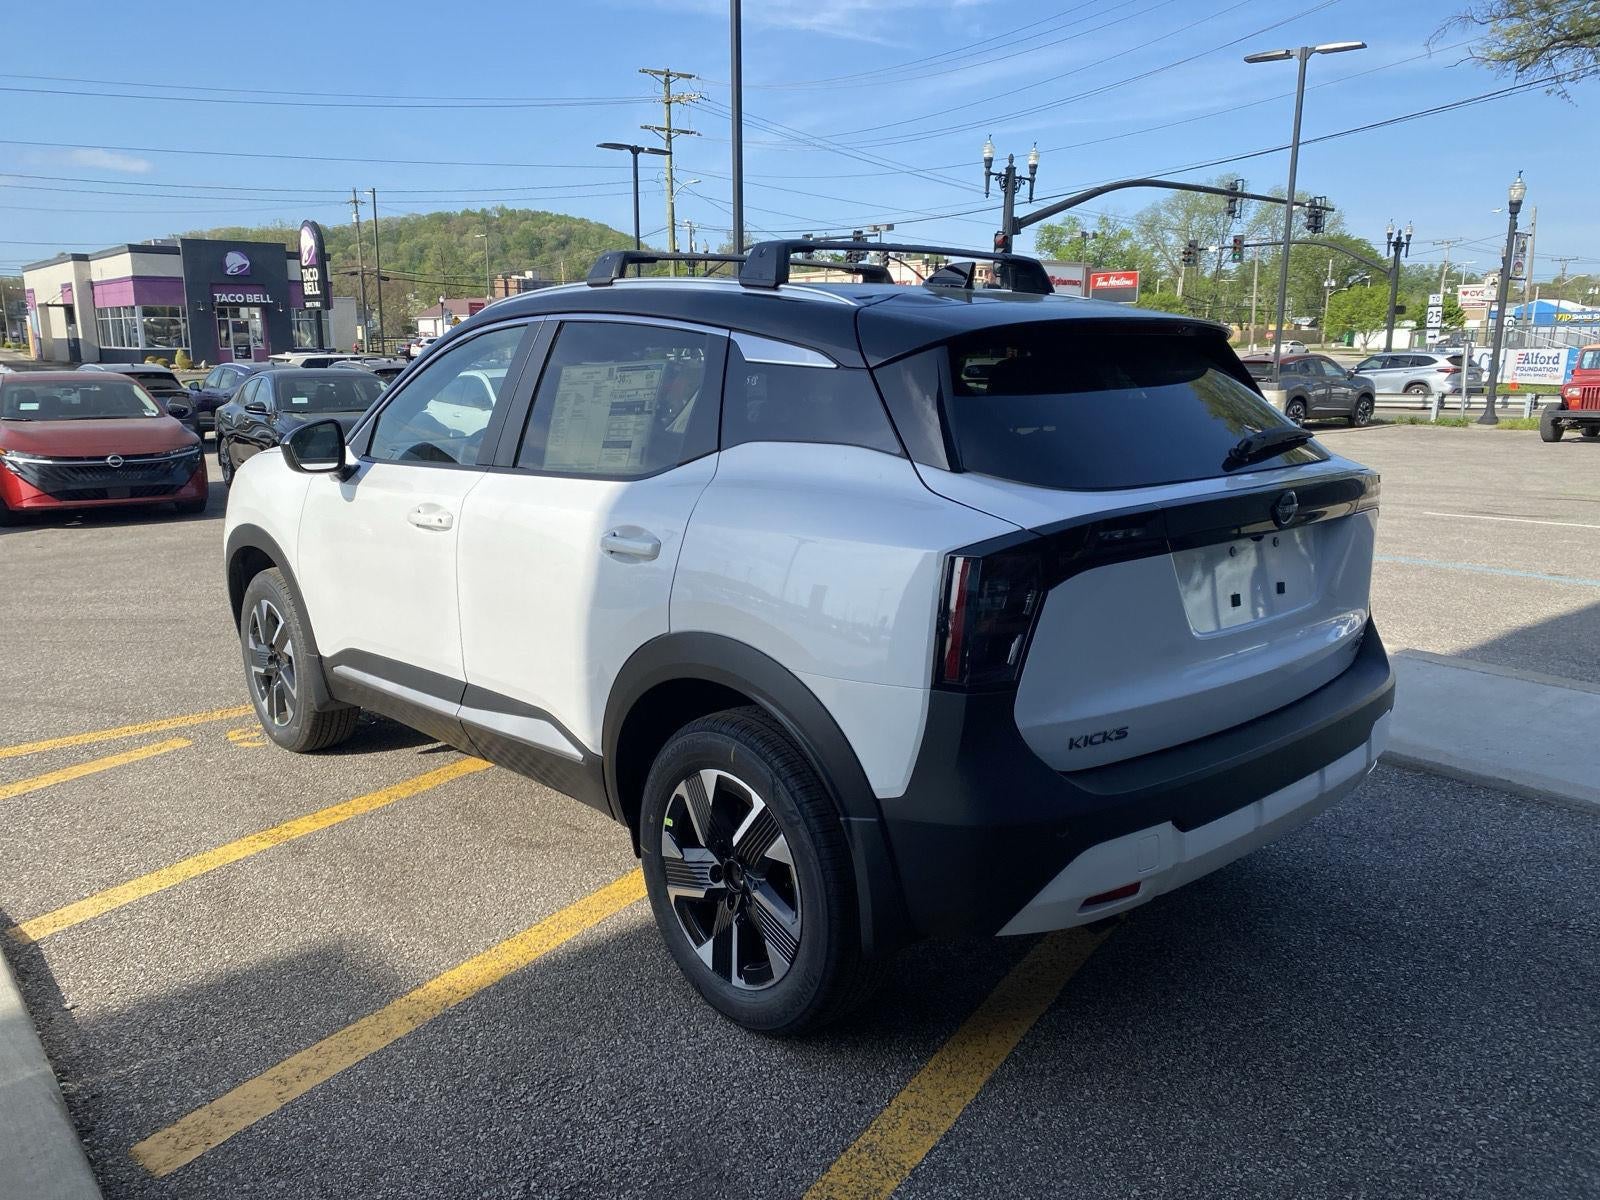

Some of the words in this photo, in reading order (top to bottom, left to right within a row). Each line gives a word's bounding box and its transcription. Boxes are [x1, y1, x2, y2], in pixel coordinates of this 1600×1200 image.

[301, 268, 318, 281] TACO
[1096, 276, 1108, 287] Tim
[1108, 275, 1133, 287] Hortons
[303, 282, 320, 295] BELL
[213, 293, 245, 303] TACO
[246, 293, 274, 303] BELL
[1428, 311, 1441, 323] 25
[1521, 352, 1560, 365] Alford
[1068, 726, 1129, 750] KICKS
